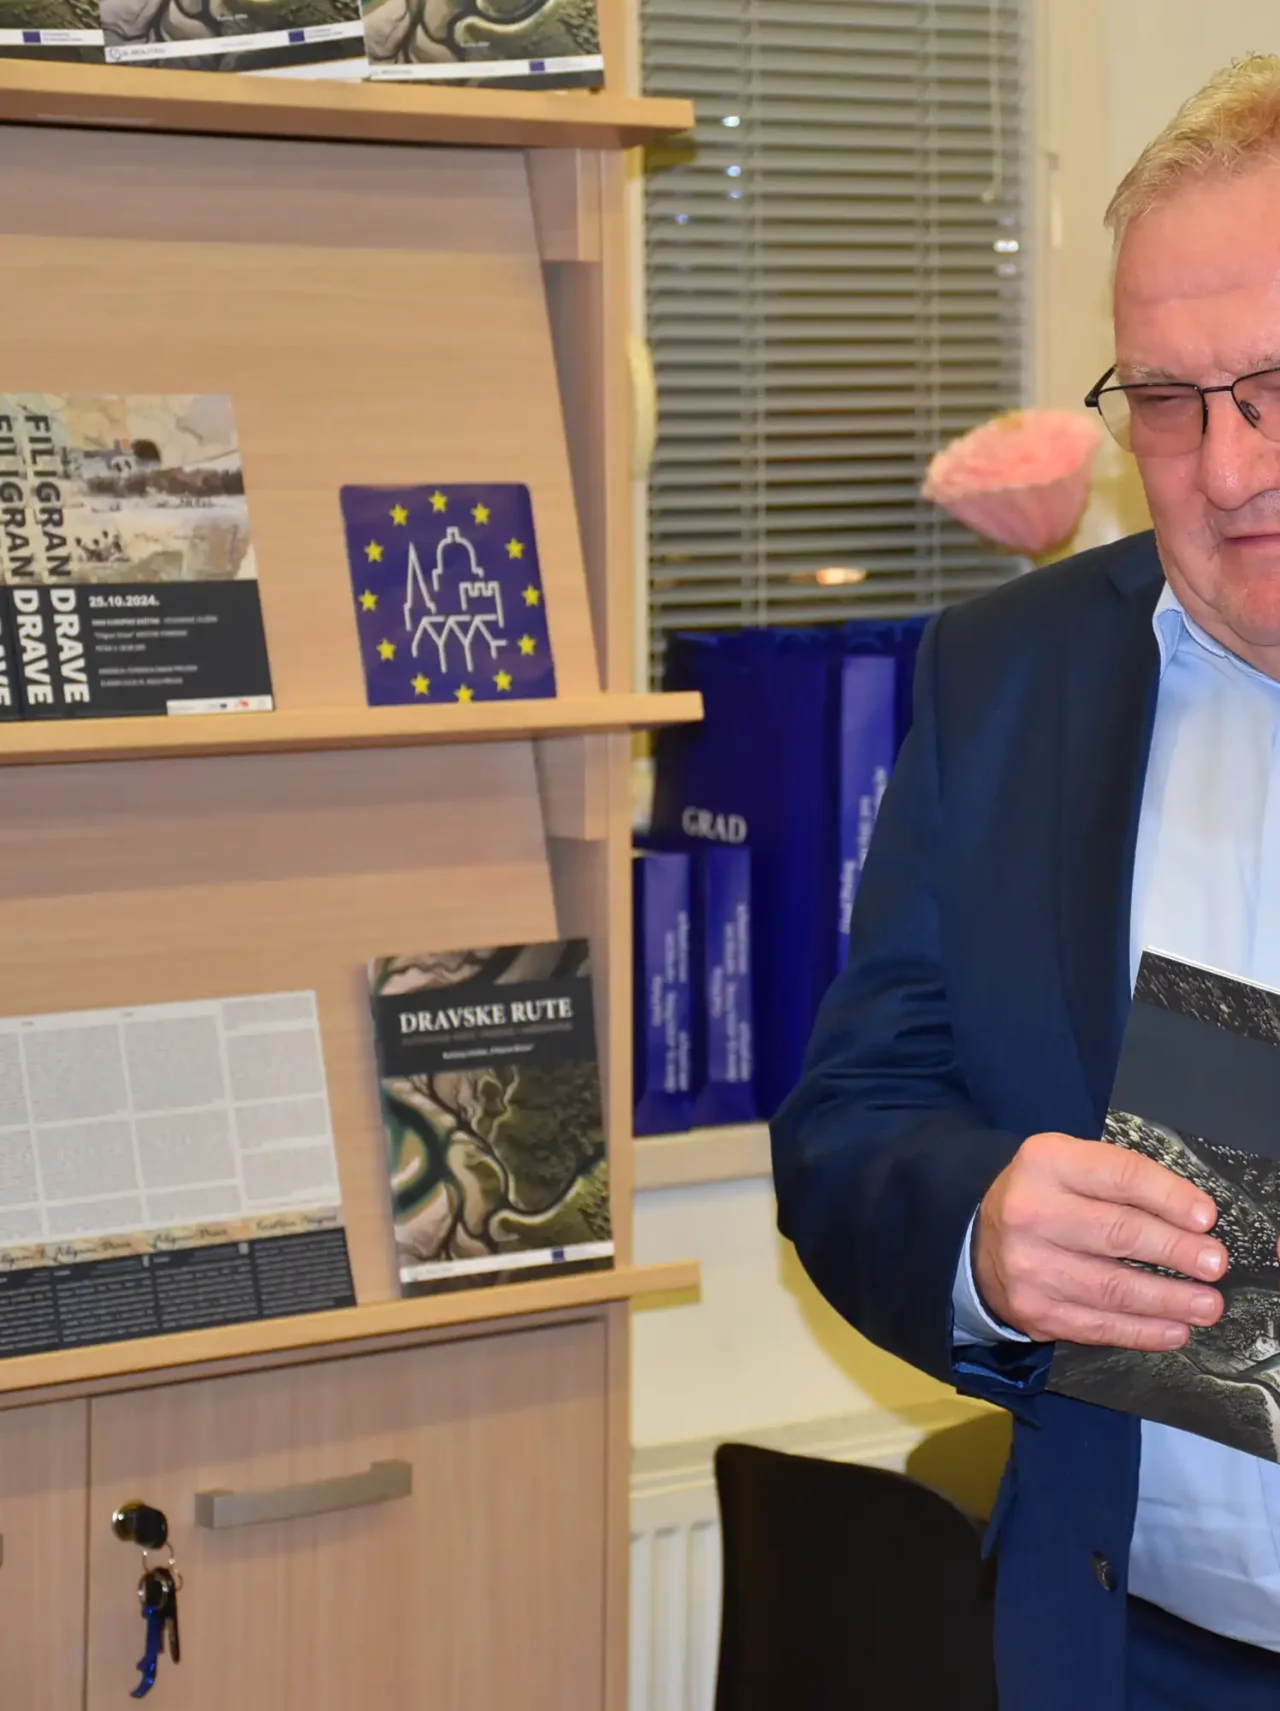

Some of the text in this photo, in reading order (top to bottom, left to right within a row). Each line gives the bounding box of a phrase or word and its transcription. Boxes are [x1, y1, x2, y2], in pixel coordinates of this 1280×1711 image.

[25, 415, 90, 704] FILIGRAN DRAVE
[89, 594, 160, 608] 25.10.2024.
[13, 588, 54, 705] DRAVE
[682, 805, 748, 845] GRAD
[398, 1003, 506, 1034] DRAVSKE
[511, 996, 574, 1023] RUTE
